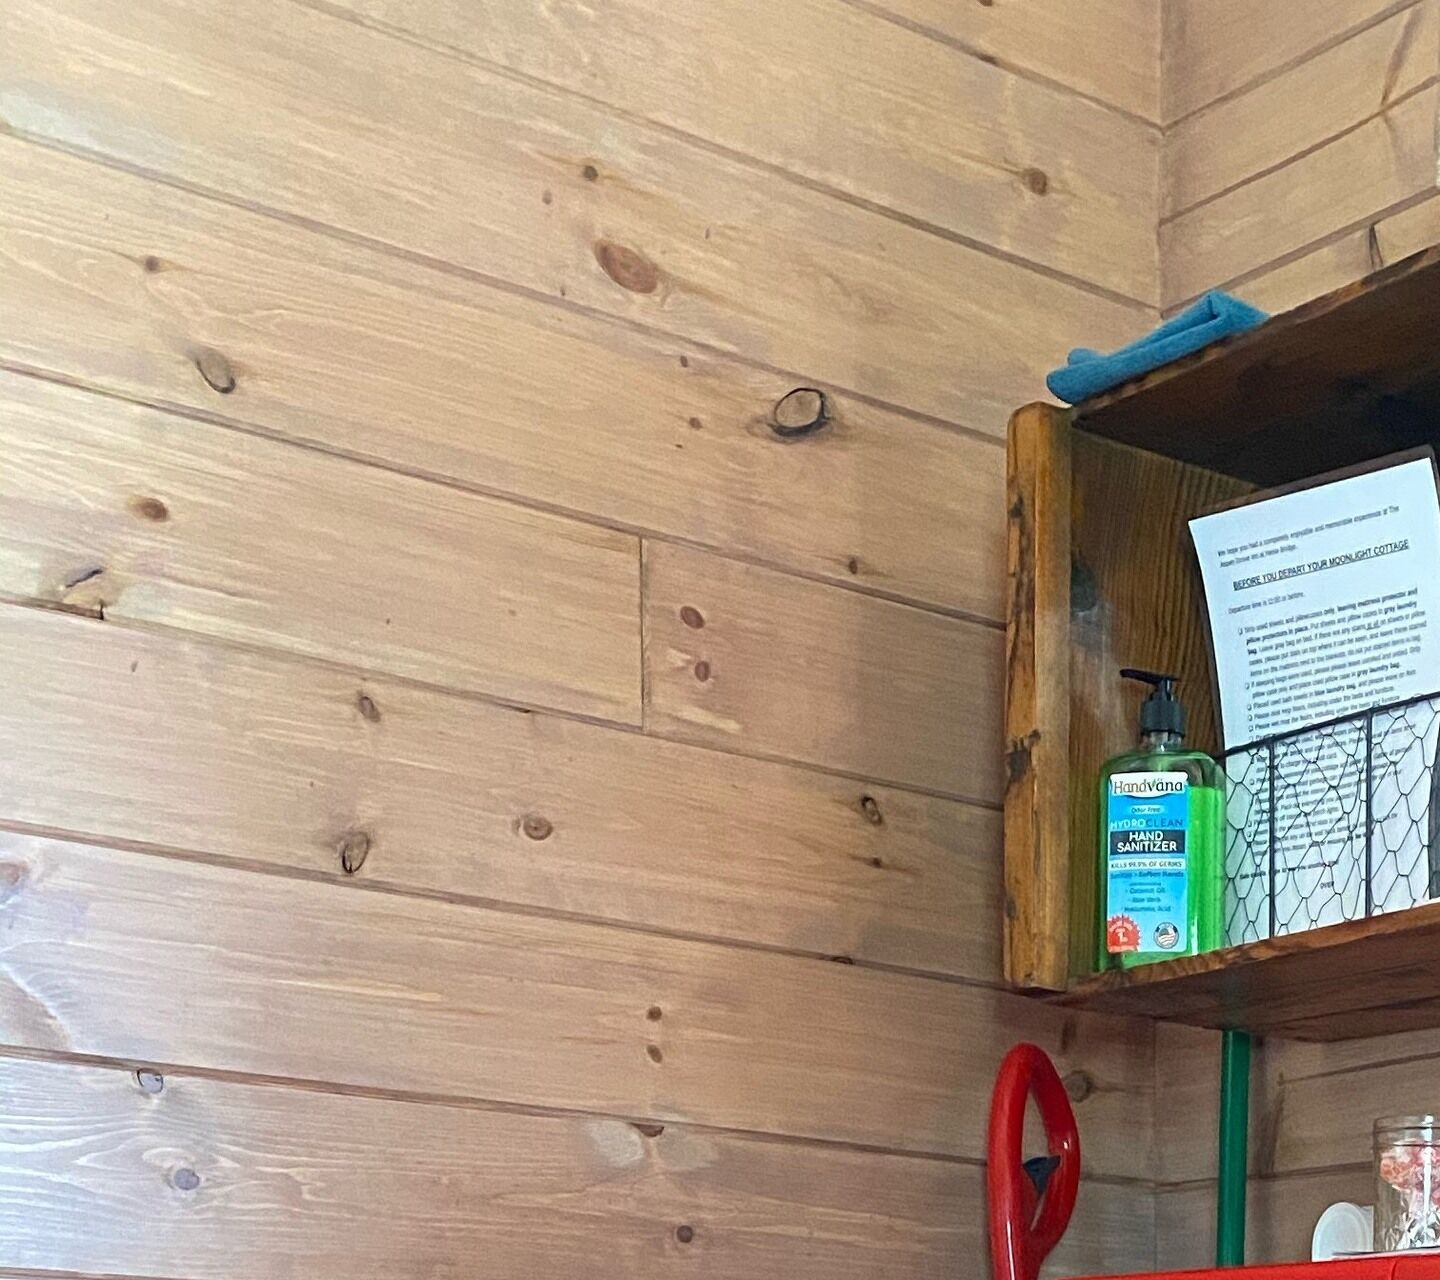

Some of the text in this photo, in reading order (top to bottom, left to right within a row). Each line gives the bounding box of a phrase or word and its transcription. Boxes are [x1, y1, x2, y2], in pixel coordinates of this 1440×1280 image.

[1233, 539, 1409, 591] BEFORE YOU DEPART YOUR MOONLIGHT COTTAGE
[1129, 830, 1164, 842] HAND
[1116, 840, 1177, 853] SANITIZER
